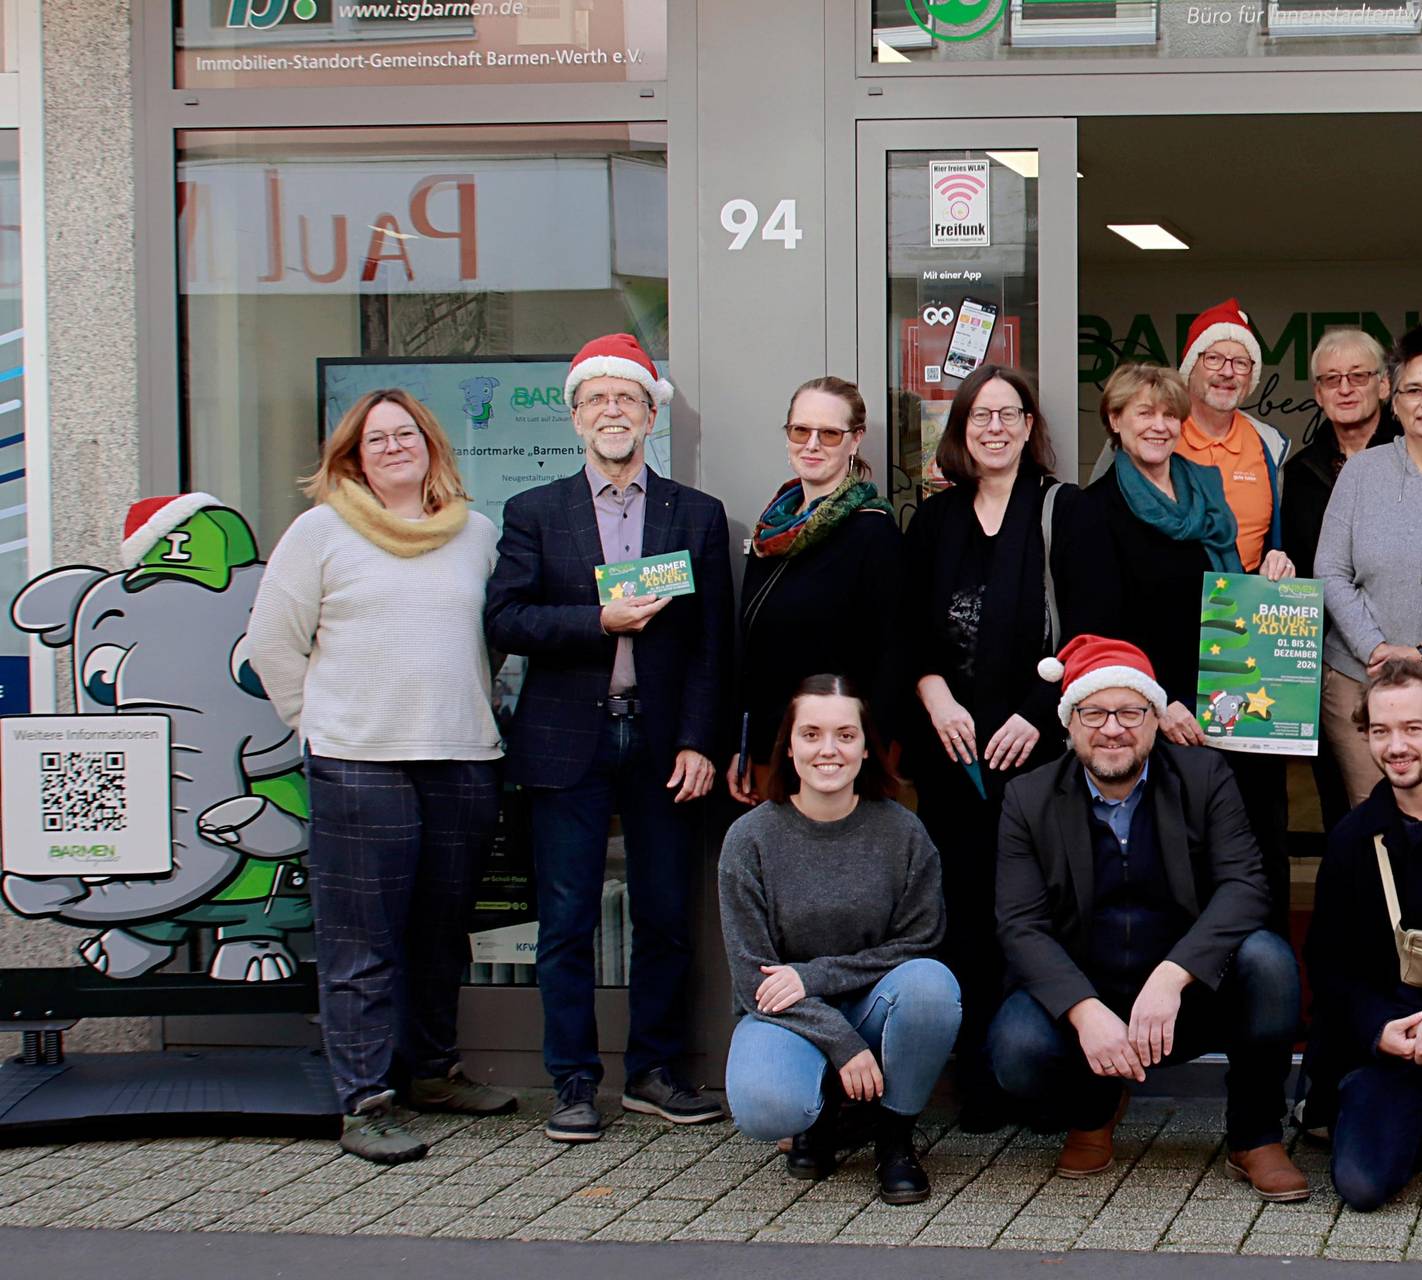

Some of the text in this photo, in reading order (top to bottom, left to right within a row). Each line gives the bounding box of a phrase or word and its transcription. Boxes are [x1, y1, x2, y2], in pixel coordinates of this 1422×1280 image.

[338, 1, 523, 21] www.isgbarmen.de
[1187, 7, 1232, 24] Büro
[1238, 5, 1265, 24] für
[196, 48, 642, 72] Immobilien-Standort-Gemeinschaft Barmen-Werth e.V.
[720, 198, 803, 250] 94
[934, 223, 986, 237] Freifunk
[923, 270, 982, 281] Mit einer App
[1078, 311, 1420, 385] BAMEN
[513, 387, 566, 406] BAR
[551, 415, 571, 423] Zukun
[453, 445, 525, 457] tandortmarke
[502, 473, 555, 483] Neugestaltung
[642, 560, 687, 575] BARMER
[645, 573, 688, 587] ADVENT
[1259, 603, 1319, 618] BARMER
[1252, 613, 1311, 628] KULTUR-
[1258, 623, 1318, 637] ADVENT
[1277, 639, 1290, 647] 01.
[1291, 639, 1304, 648] BIS
[1274, 648, 1317, 659] DEZEMBER
[1296, 660, 1317, 669] 2024
[14, 729, 159, 741] Weitere Informationen
[50, 844, 116, 858] BARMEN
